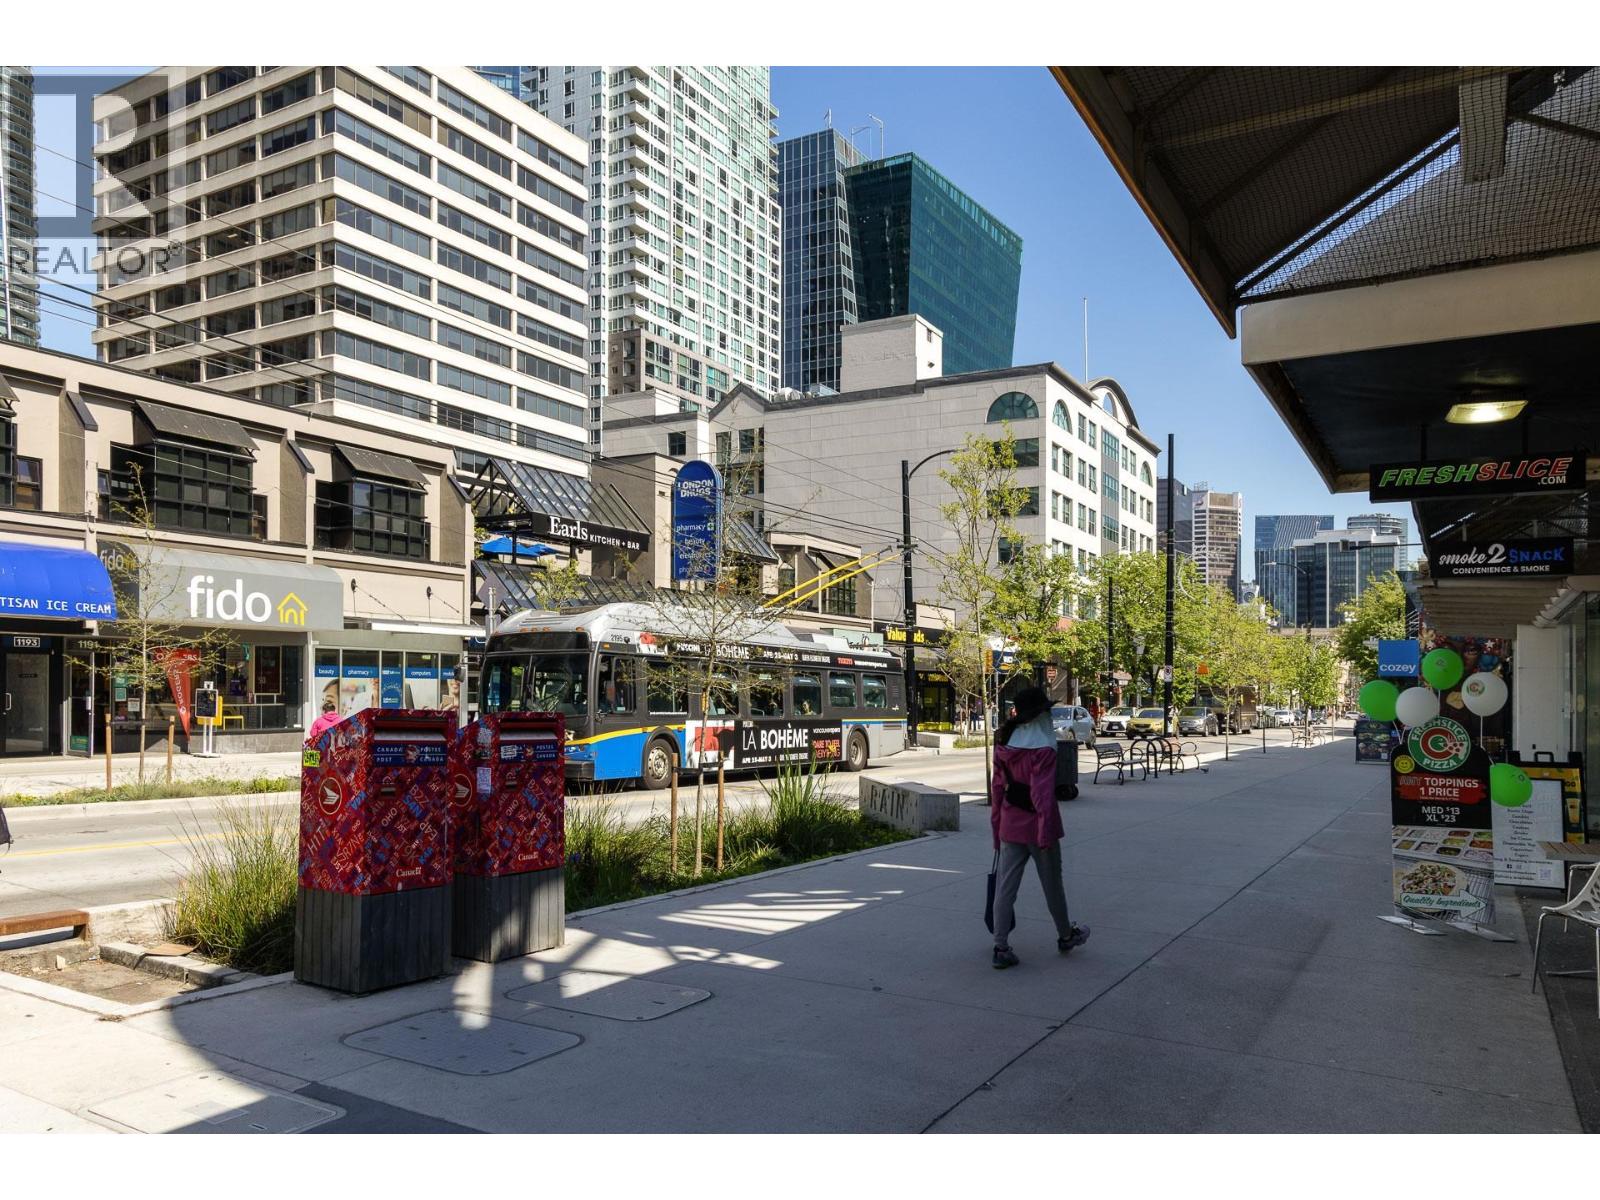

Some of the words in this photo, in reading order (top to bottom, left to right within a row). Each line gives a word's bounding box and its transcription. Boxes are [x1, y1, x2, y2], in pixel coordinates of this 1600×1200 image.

[1379, 457, 1573, 487] FRESHSLICE
[677, 479, 714, 491] LONDON
[1537, 475, 1567, 486] .COM
[550, 515, 588, 541] Earls
[590, 532, 621, 547] KITCHEN
[627, 541, 640, 550] BAR
[676, 523, 706, 533] pharmacy
[1439, 547, 1486, 565] smoke
[1487, 543, 1507, 564] 2
[1509, 547, 1565, 564] SNACK
[1452, 566, 1512, 575] CONVENIENCE
[1520, 565, 1550, 573] SMOKE
[187, 575, 271, 622] fido
[46, 600, 68, 611] ICE
[75, 603, 112, 614] CREAM
[17, 639, 38, 647] 1193
[318, 668, 335, 676] beauty
[1380, 663, 1416, 675] cozey
[743, 730, 757, 751] LA
[760, 722, 809, 750] BOHÈME
[1422, 758, 1458, 770] PIZZA
[1424, 777, 1479, 789] TOPPINGS
[1420, 787, 1425, 796] 1
[1428, 787, 1460, 797] PRICE
[1422, 806, 1444, 815] MED
[1446, 807, 1461, 815] $13
[1425, 814, 1438, 822] XL
[1441, 815, 1457, 823] $23
[1403, 894, 1434, 907] Quality
[1436, 897, 1481, 908] Ingredients
